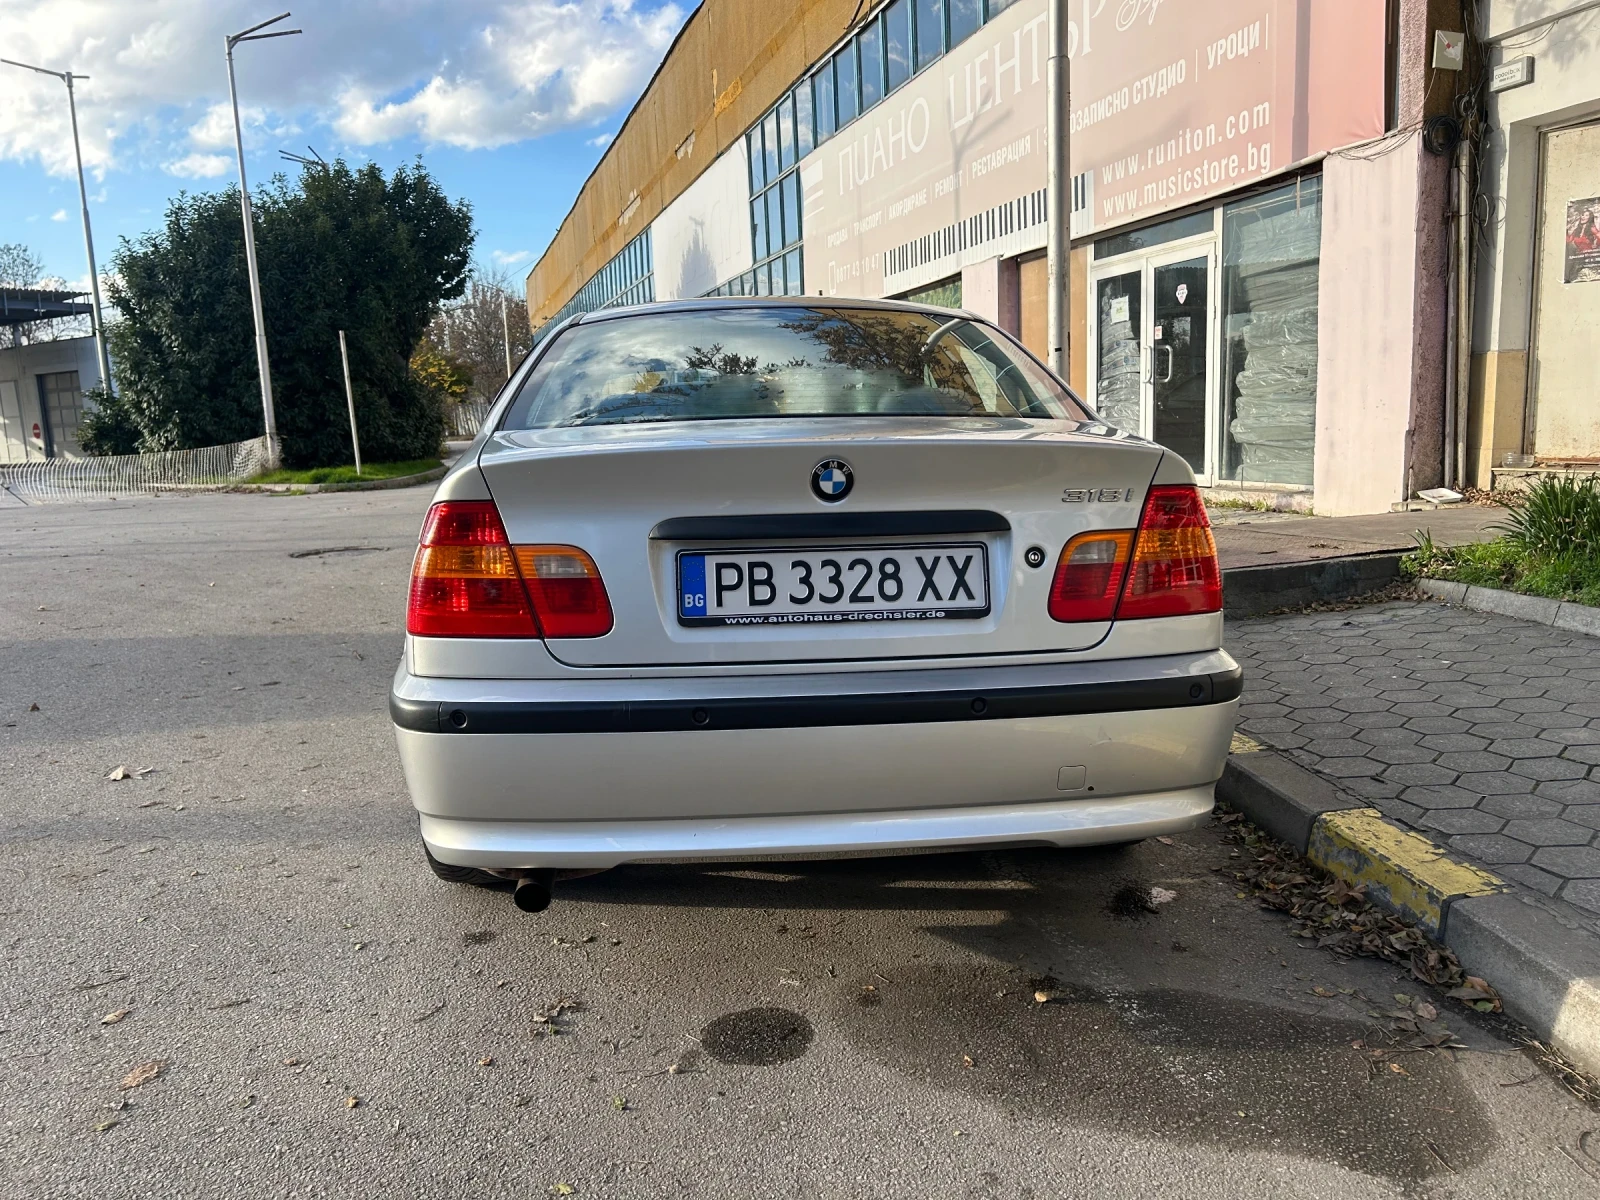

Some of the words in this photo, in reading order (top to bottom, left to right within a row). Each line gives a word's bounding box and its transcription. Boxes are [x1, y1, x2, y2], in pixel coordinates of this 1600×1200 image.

[853, 210, 882, 237] ТРАНСПОРТ
[888, 188, 927, 221] АКОРДИРАНЕ
[935, 170, 963, 198] РЕМОНТ
[972, 134, 1031, 180] РЕСТАВРАЦИЯ
[1132, 58, 1186, 105] СТУДИО
[1207, 20, 1260, 70] УРОЦИ
[1102, 101, 1270, 185] www.runiton.com
[1103, 142, 1271, 218] www.musicstore.bg
[815, 461, 851, 475] BMW
[684, 593, 704, 608] BG
[714, 561, 777, 608] PB
[787, 557, 904, 605] 3328
[915, 555, 976, 602] XX
[724, 610, 946, 625] www.autohaus-drechsler.de
